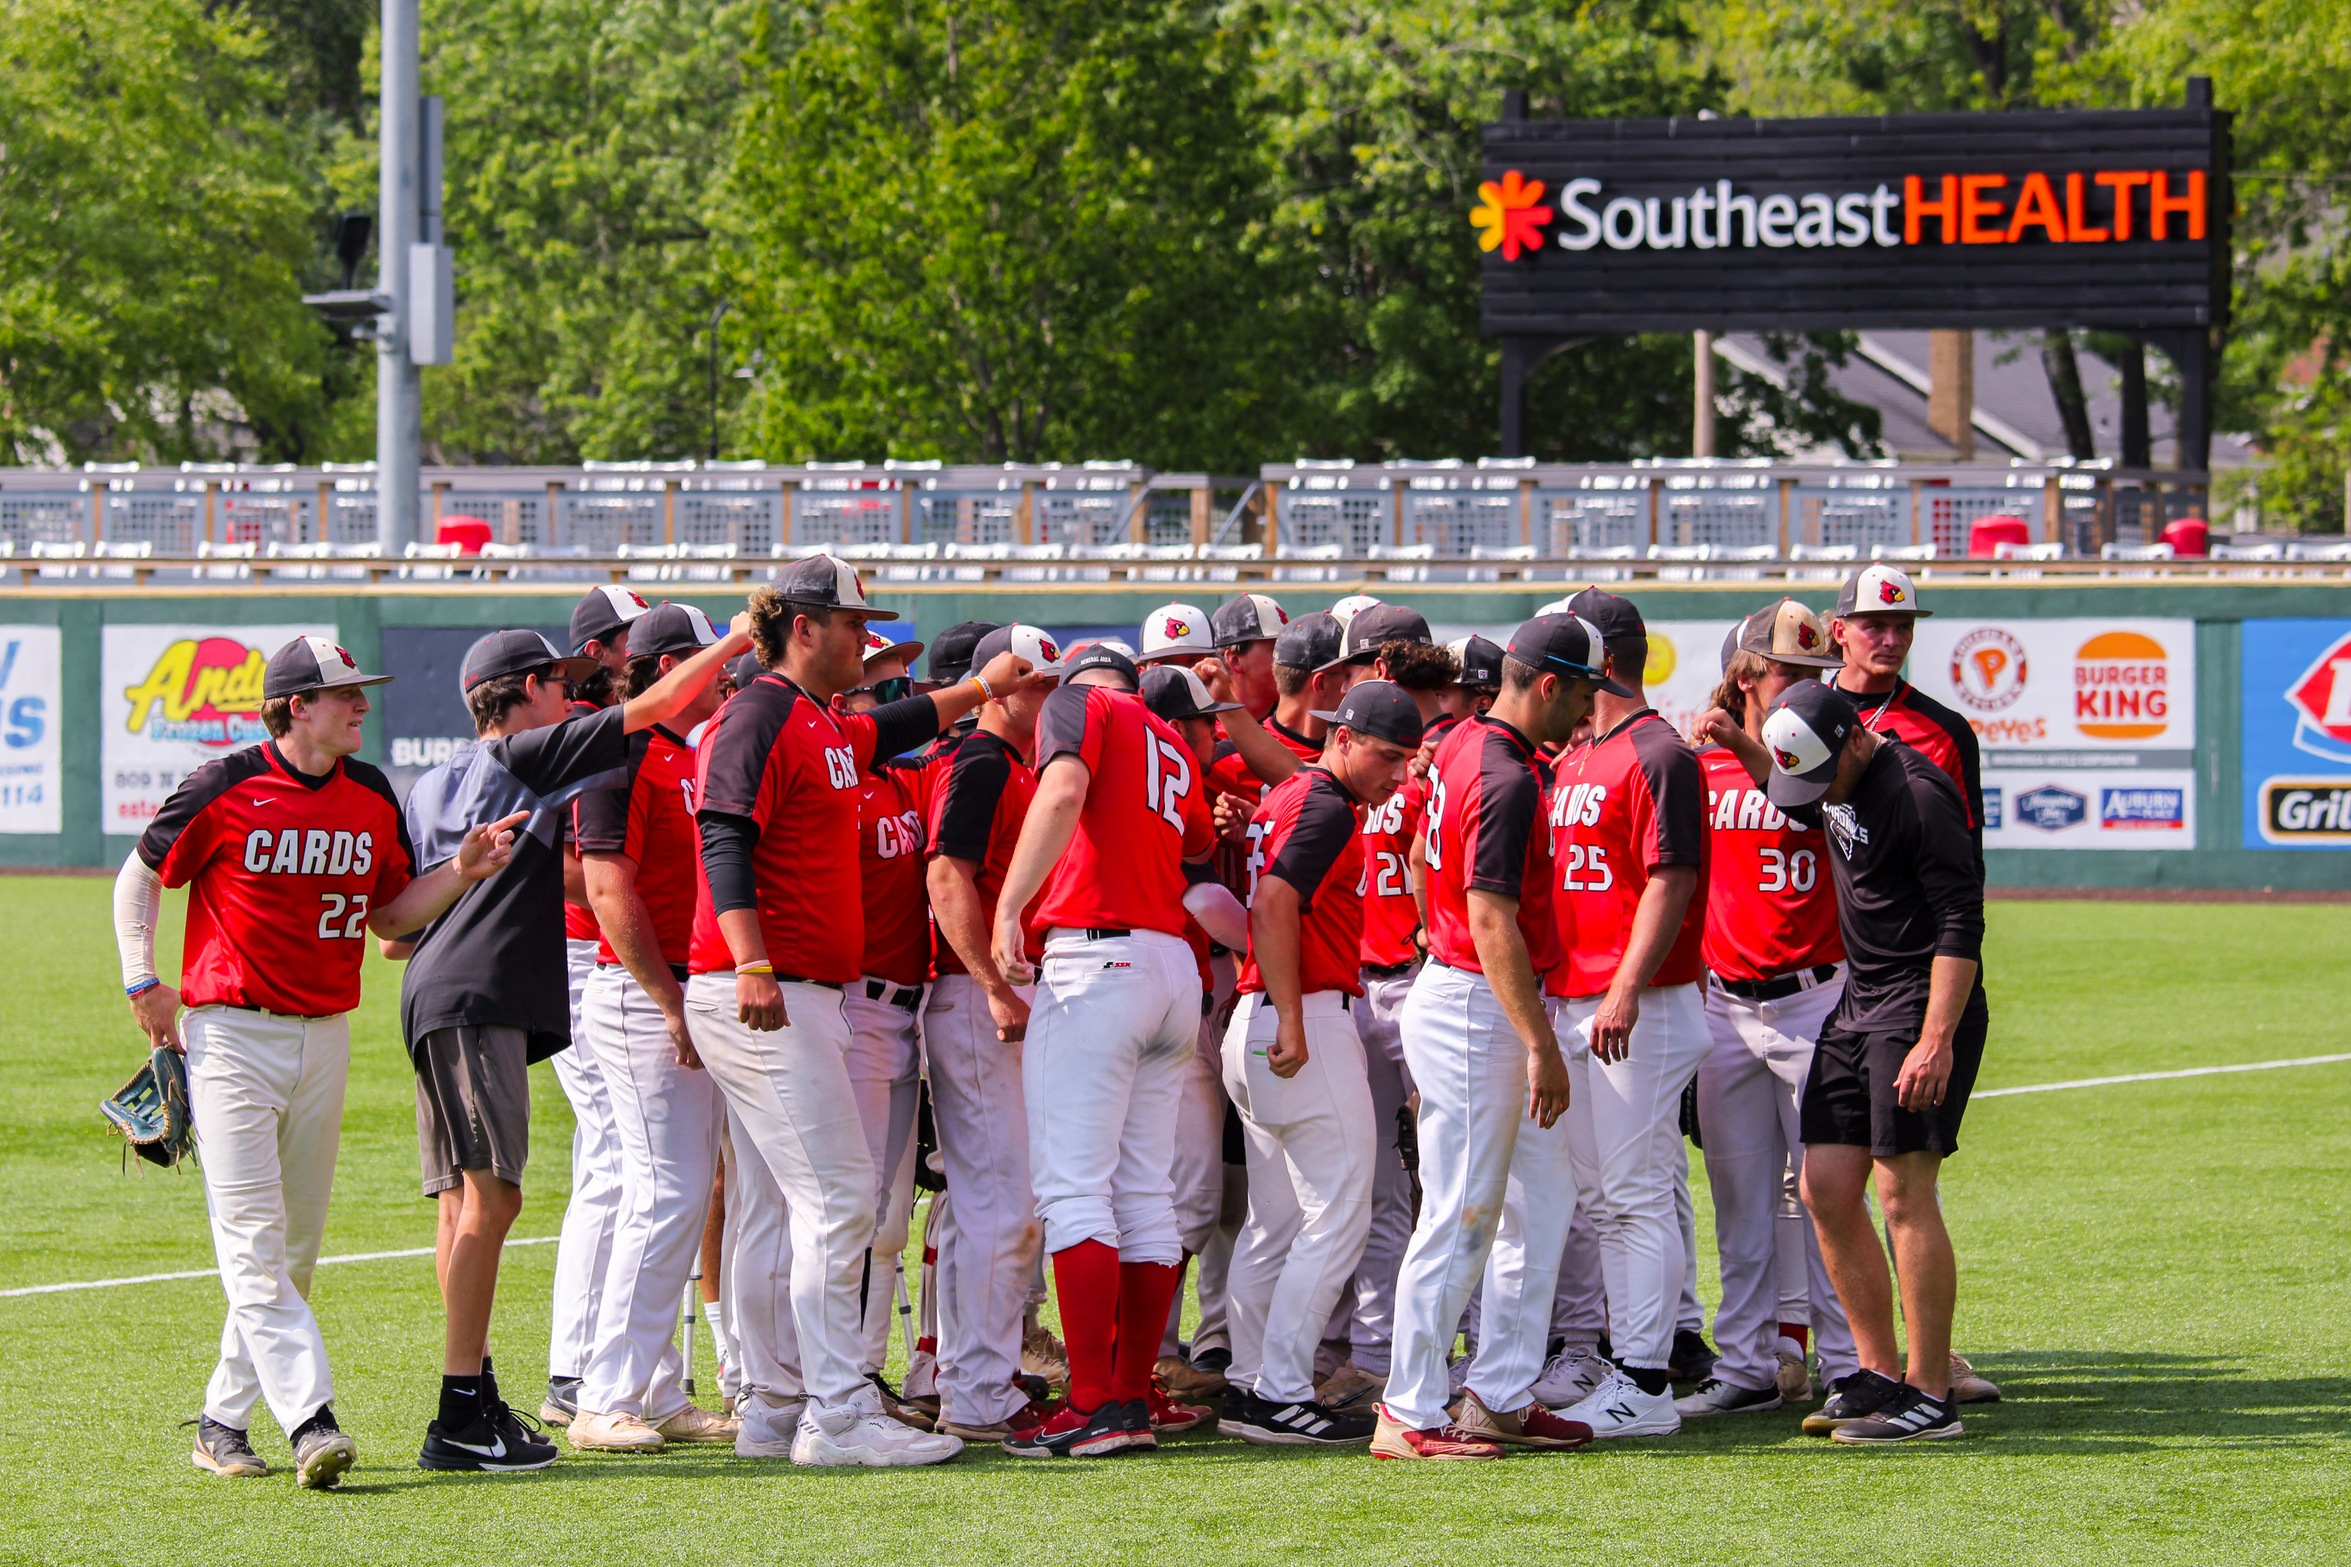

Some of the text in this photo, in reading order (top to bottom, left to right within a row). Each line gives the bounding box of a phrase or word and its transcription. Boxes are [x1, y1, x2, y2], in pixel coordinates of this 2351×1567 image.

[1559, 171, 2206, 250] SoutheastHEALTH
[1100, 656, 1112, 664] AREA
[2075, 665, 2168, 684] BURGER
[2076, 690, 2168, 718] KING
[160, 771, 174, 788] N
[1144, 723, 1190, 837] 12
[243, 829, 373, 876] CARDS
[1563, 844, 1613, 892] 25
[1758, 848, 1816, 892] 30
[318, 893, 369, 940] 22
